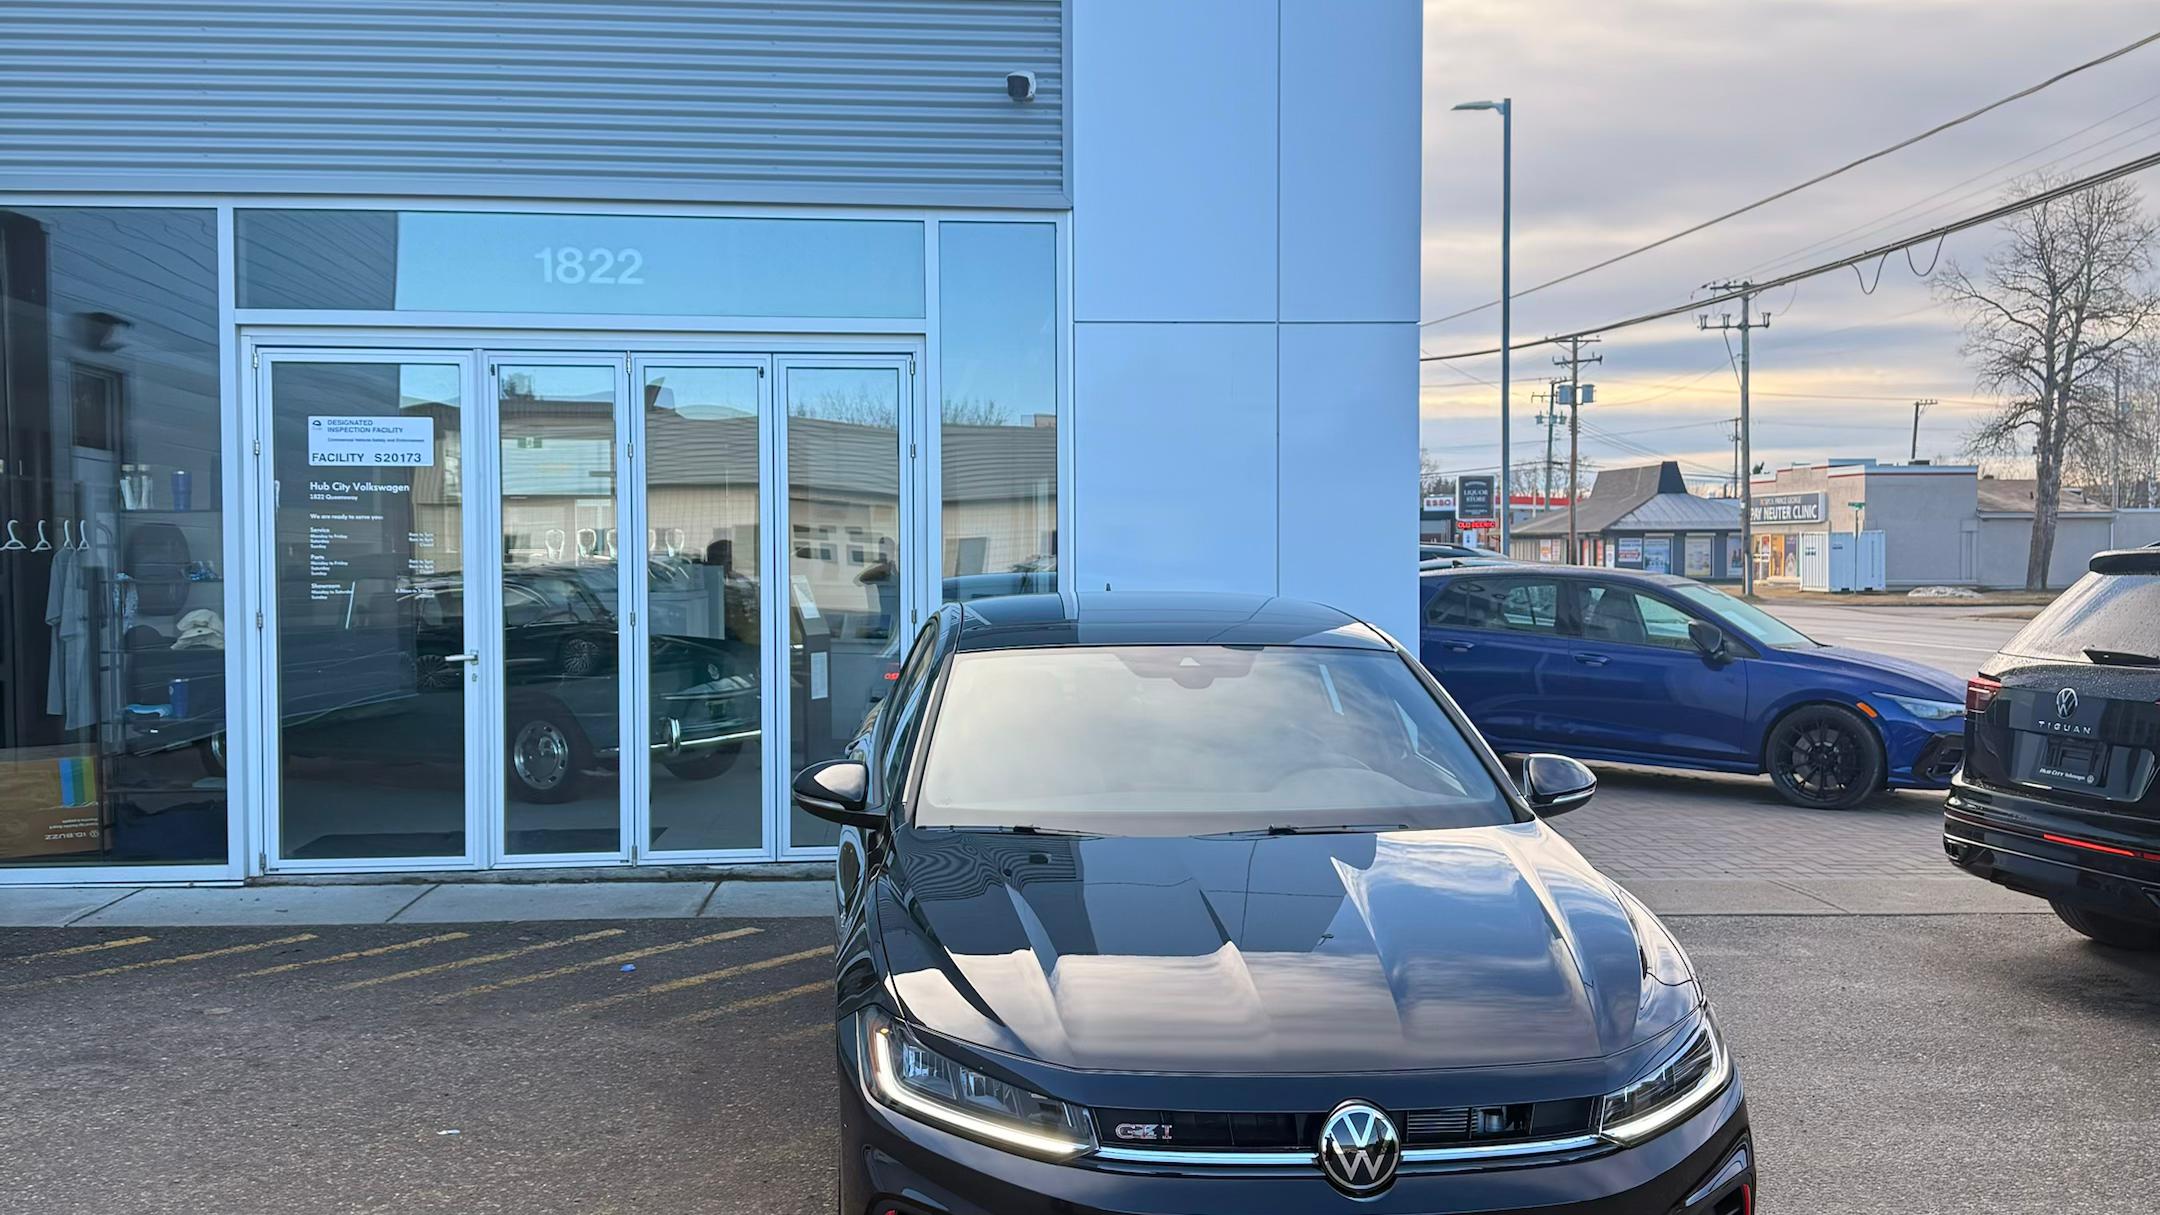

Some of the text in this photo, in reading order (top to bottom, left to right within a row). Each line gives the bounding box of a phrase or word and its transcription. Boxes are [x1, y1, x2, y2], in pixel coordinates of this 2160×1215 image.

[534, 247, 645, 284] 1822
[312, 453, 422, 463] FACILITY S20173
[310, 481, 410, 494] Hub City Volkswagen
[1750, 504, 1818, 521] PAY NEUTER CLINIC
[2039, 720, 2091, 734] TIGUAN
[1115, 1123, 1172, 1139] GTI
